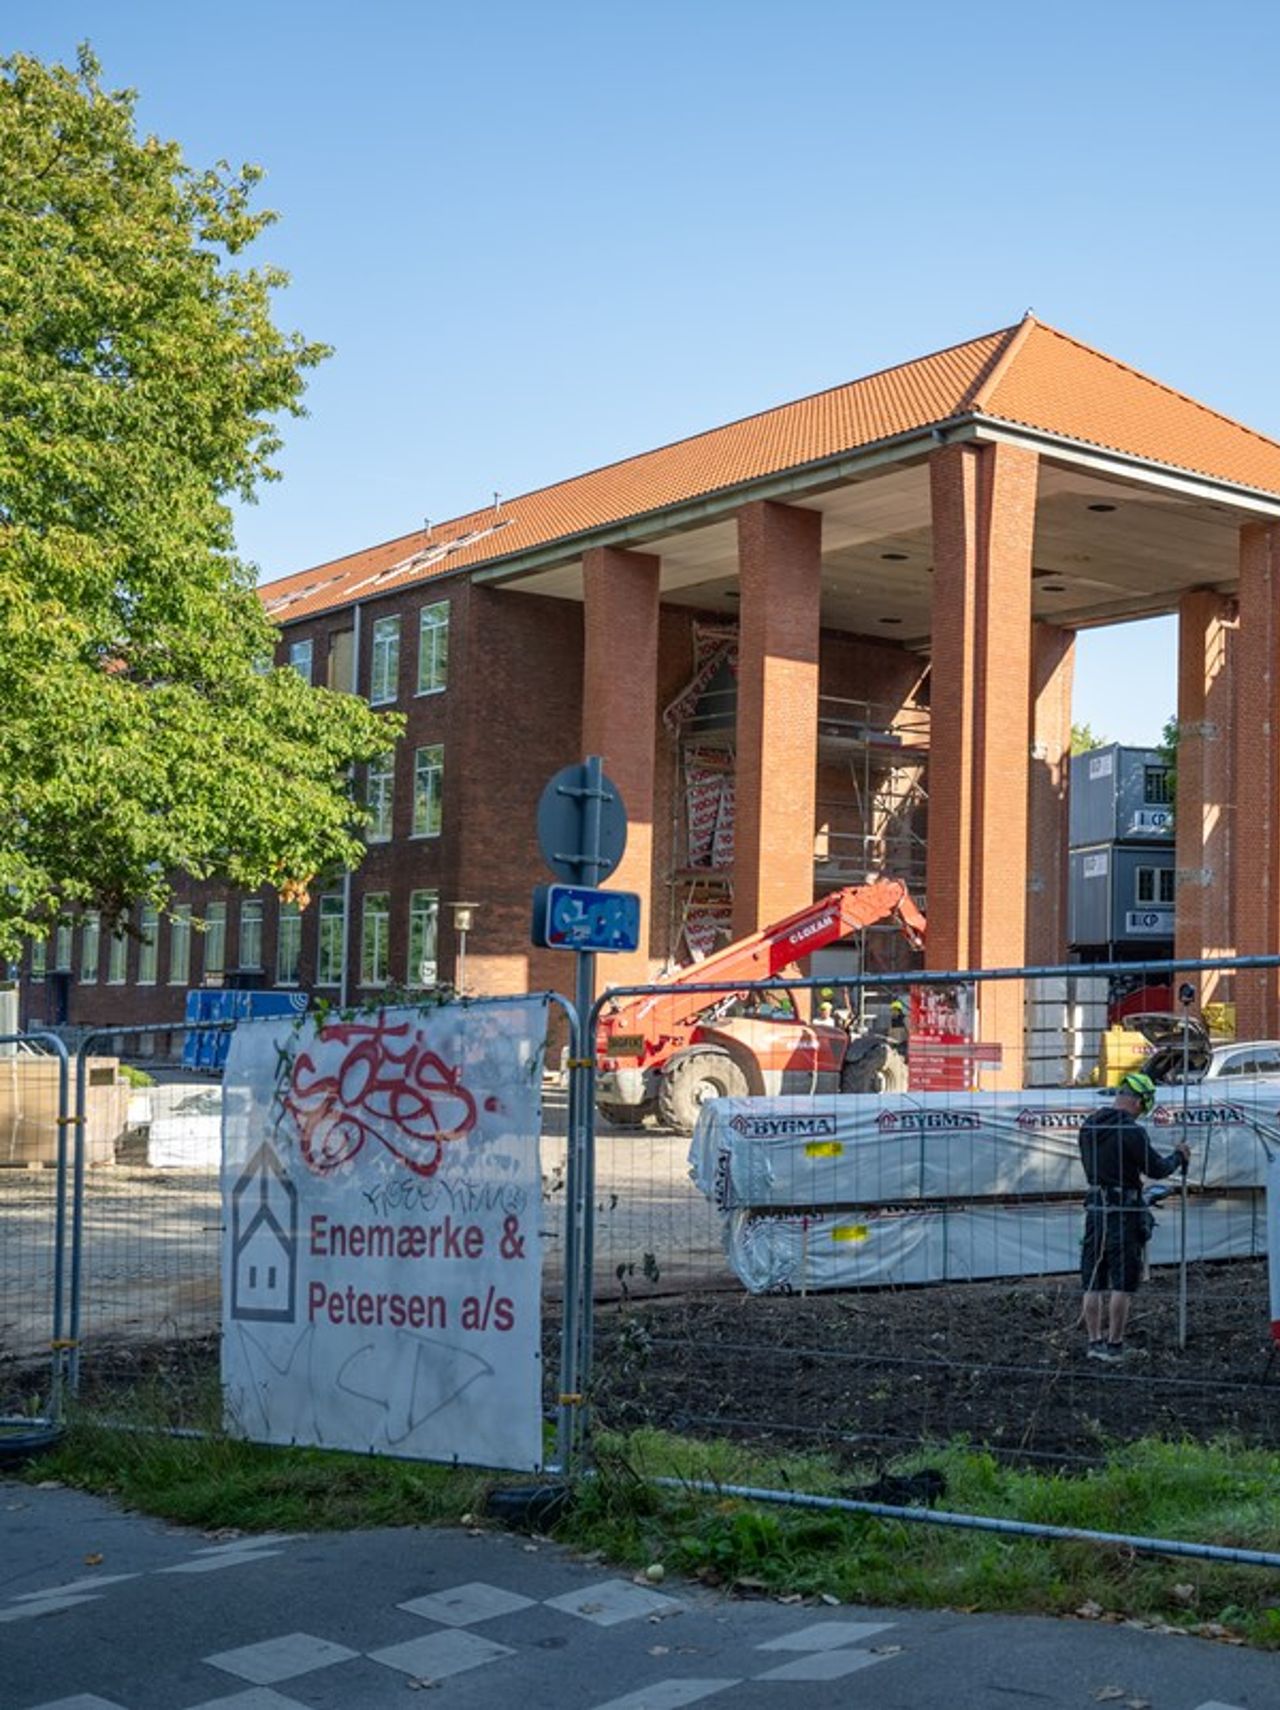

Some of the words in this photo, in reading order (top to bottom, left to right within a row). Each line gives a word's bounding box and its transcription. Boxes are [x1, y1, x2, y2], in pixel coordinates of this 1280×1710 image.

[754, 1118, 832, 1136] BYGMA
[901, 1112, 974, 1128] BYGMA
[309, 1213, 485, 1259] Enemærke
[499, 1214, 526, 1259] &
[308, 1281, 446, 1329] Petersen
[461, 1286, 515, 1331] a/s
